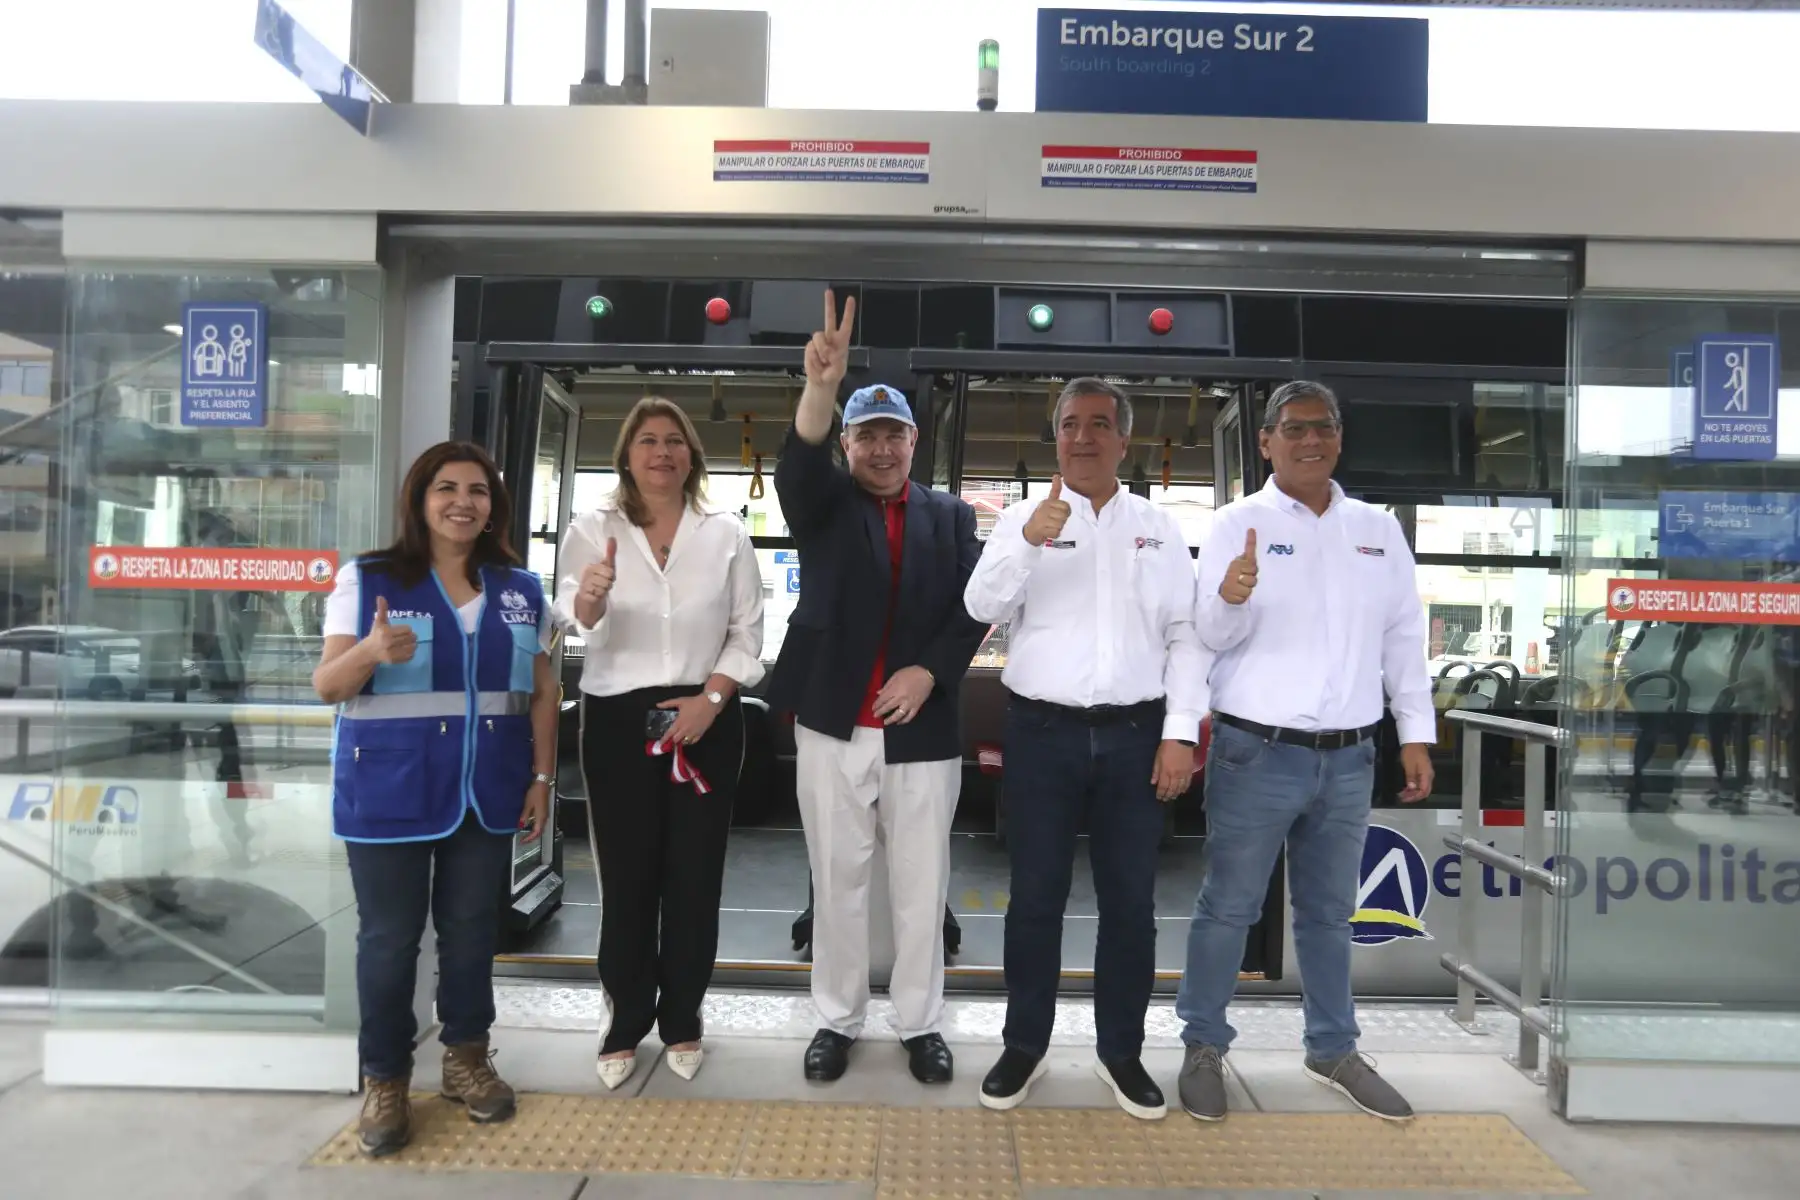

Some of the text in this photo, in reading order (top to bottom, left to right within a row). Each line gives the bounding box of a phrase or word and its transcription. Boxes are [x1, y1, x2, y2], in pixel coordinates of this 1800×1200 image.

[1060, 18, 1314, 54] Embarque Sur 2
[1060, 56, 1211, 77] South boarding 2
[790, 142, 854, 152] PROHIBIDO
[1118, 149, 1182, 160] PROHIBIDO
[719, 156, 926, 169] MANIPULAR O FORZAR LAS PUERTAS DE EMBARQUE
[1047, 163, 1253, 178] MANIPULAR O FORZAR LAS PUERTAS DE EMBARQUE
[186, 388, 256, 397] RESPETA LA FILA
[192, 399, 250, 409] Y EL ASIENTO
[190, 411, 252, 420] PREFERENCIAL
[1704, 423, 1768, 433] NO TE APOYES
[1700, 434, 1772, 444] EN LAS PUERTAS
[1703, 502, 1787, 517] Embarque Sur
[1703, 517, 1753, 528] Puerta 1
[121, 557, 305, 581] RESPETA LA ZONA DE SEGURIDAD
[1638, 590, 1688, 611] RESPETA
[1690, 591, 1705, 611] LA
[1707, 592, 1739, 612] ZONA
[1741, 593, 1756, 613] DE
[500, 613, 537, 624] LIMA
